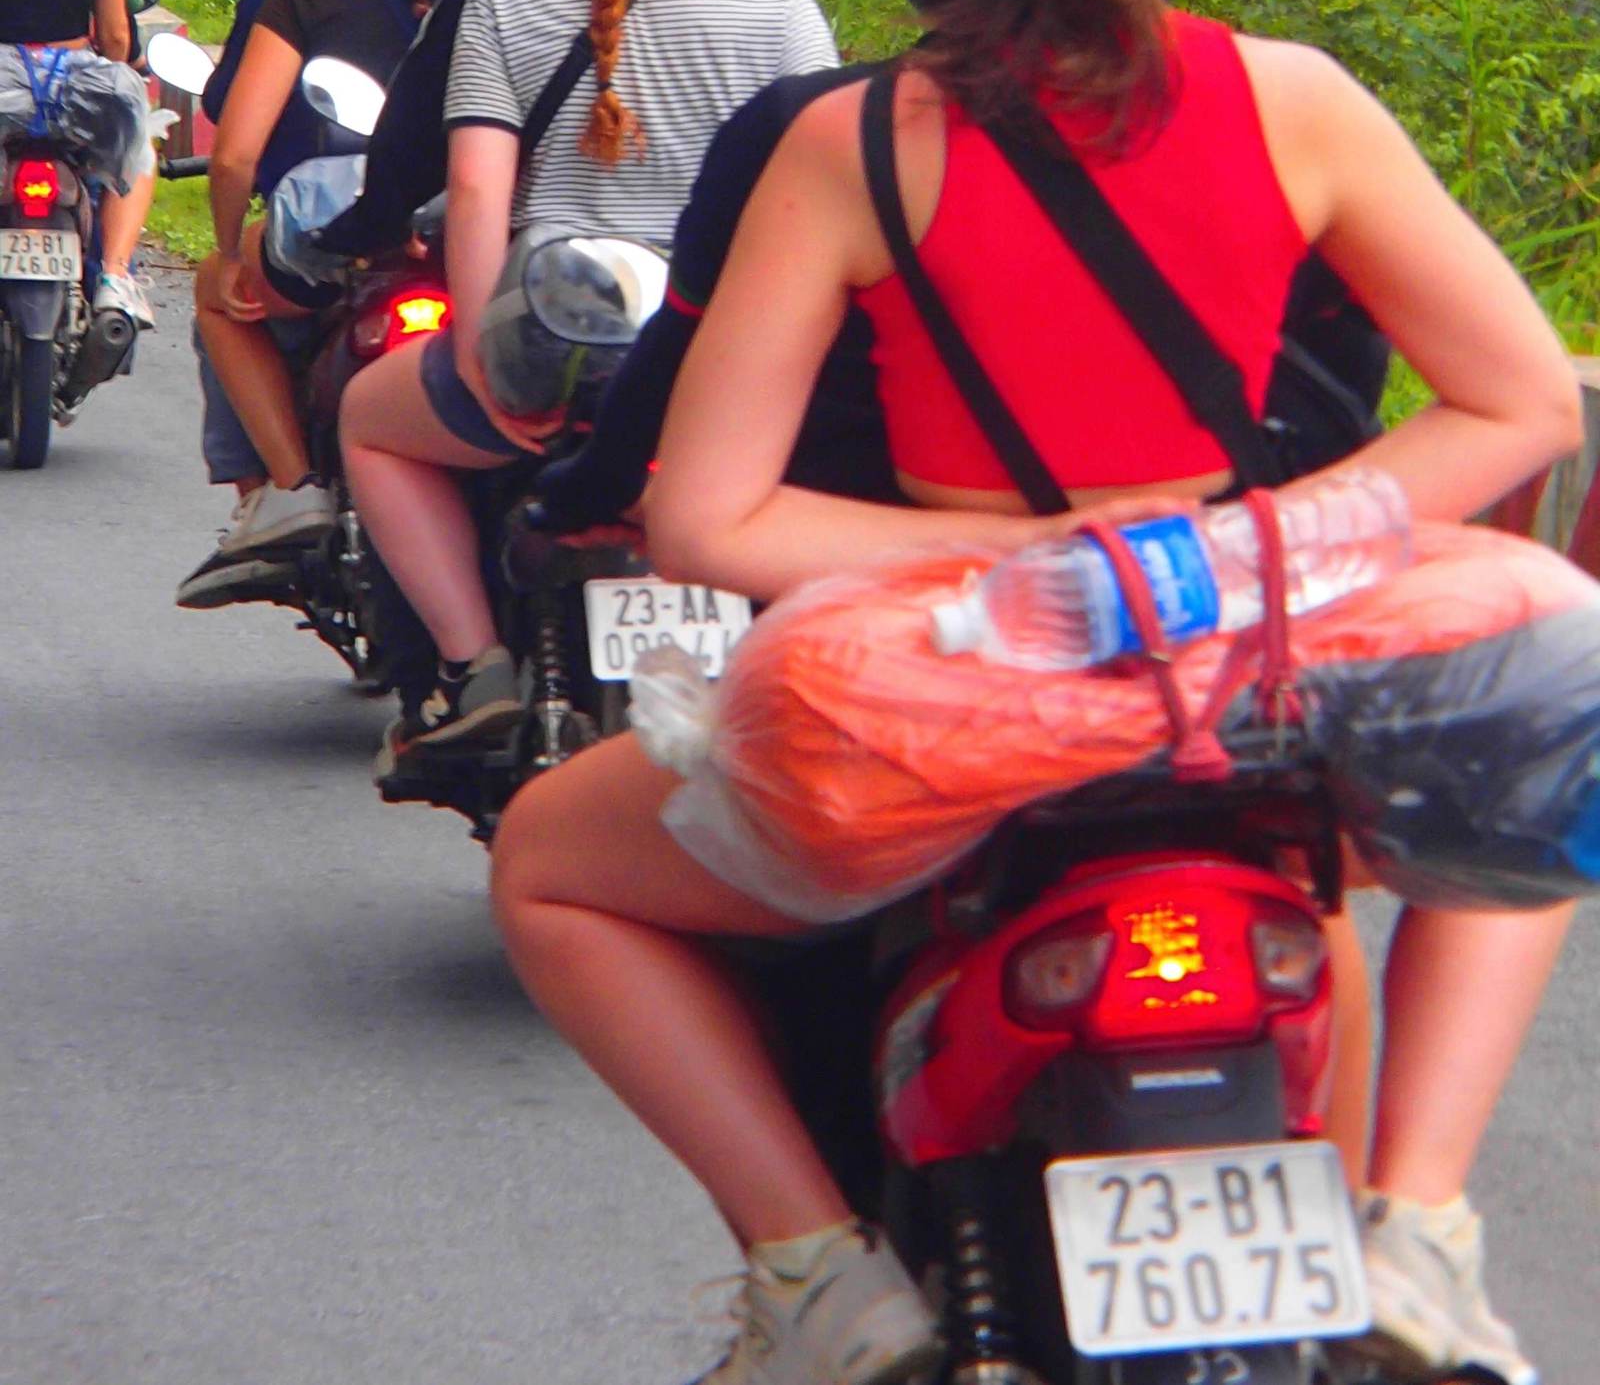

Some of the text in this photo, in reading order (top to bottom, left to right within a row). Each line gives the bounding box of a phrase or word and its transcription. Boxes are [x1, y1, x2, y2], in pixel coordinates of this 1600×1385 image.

[8, 235, 64, 254] 23-B1
[613, 585, 721, 627] 23-AA
[1099, 1162, 1293, 1247] 23-B1
[1086, 1242, 1339, 1335] 760.75
